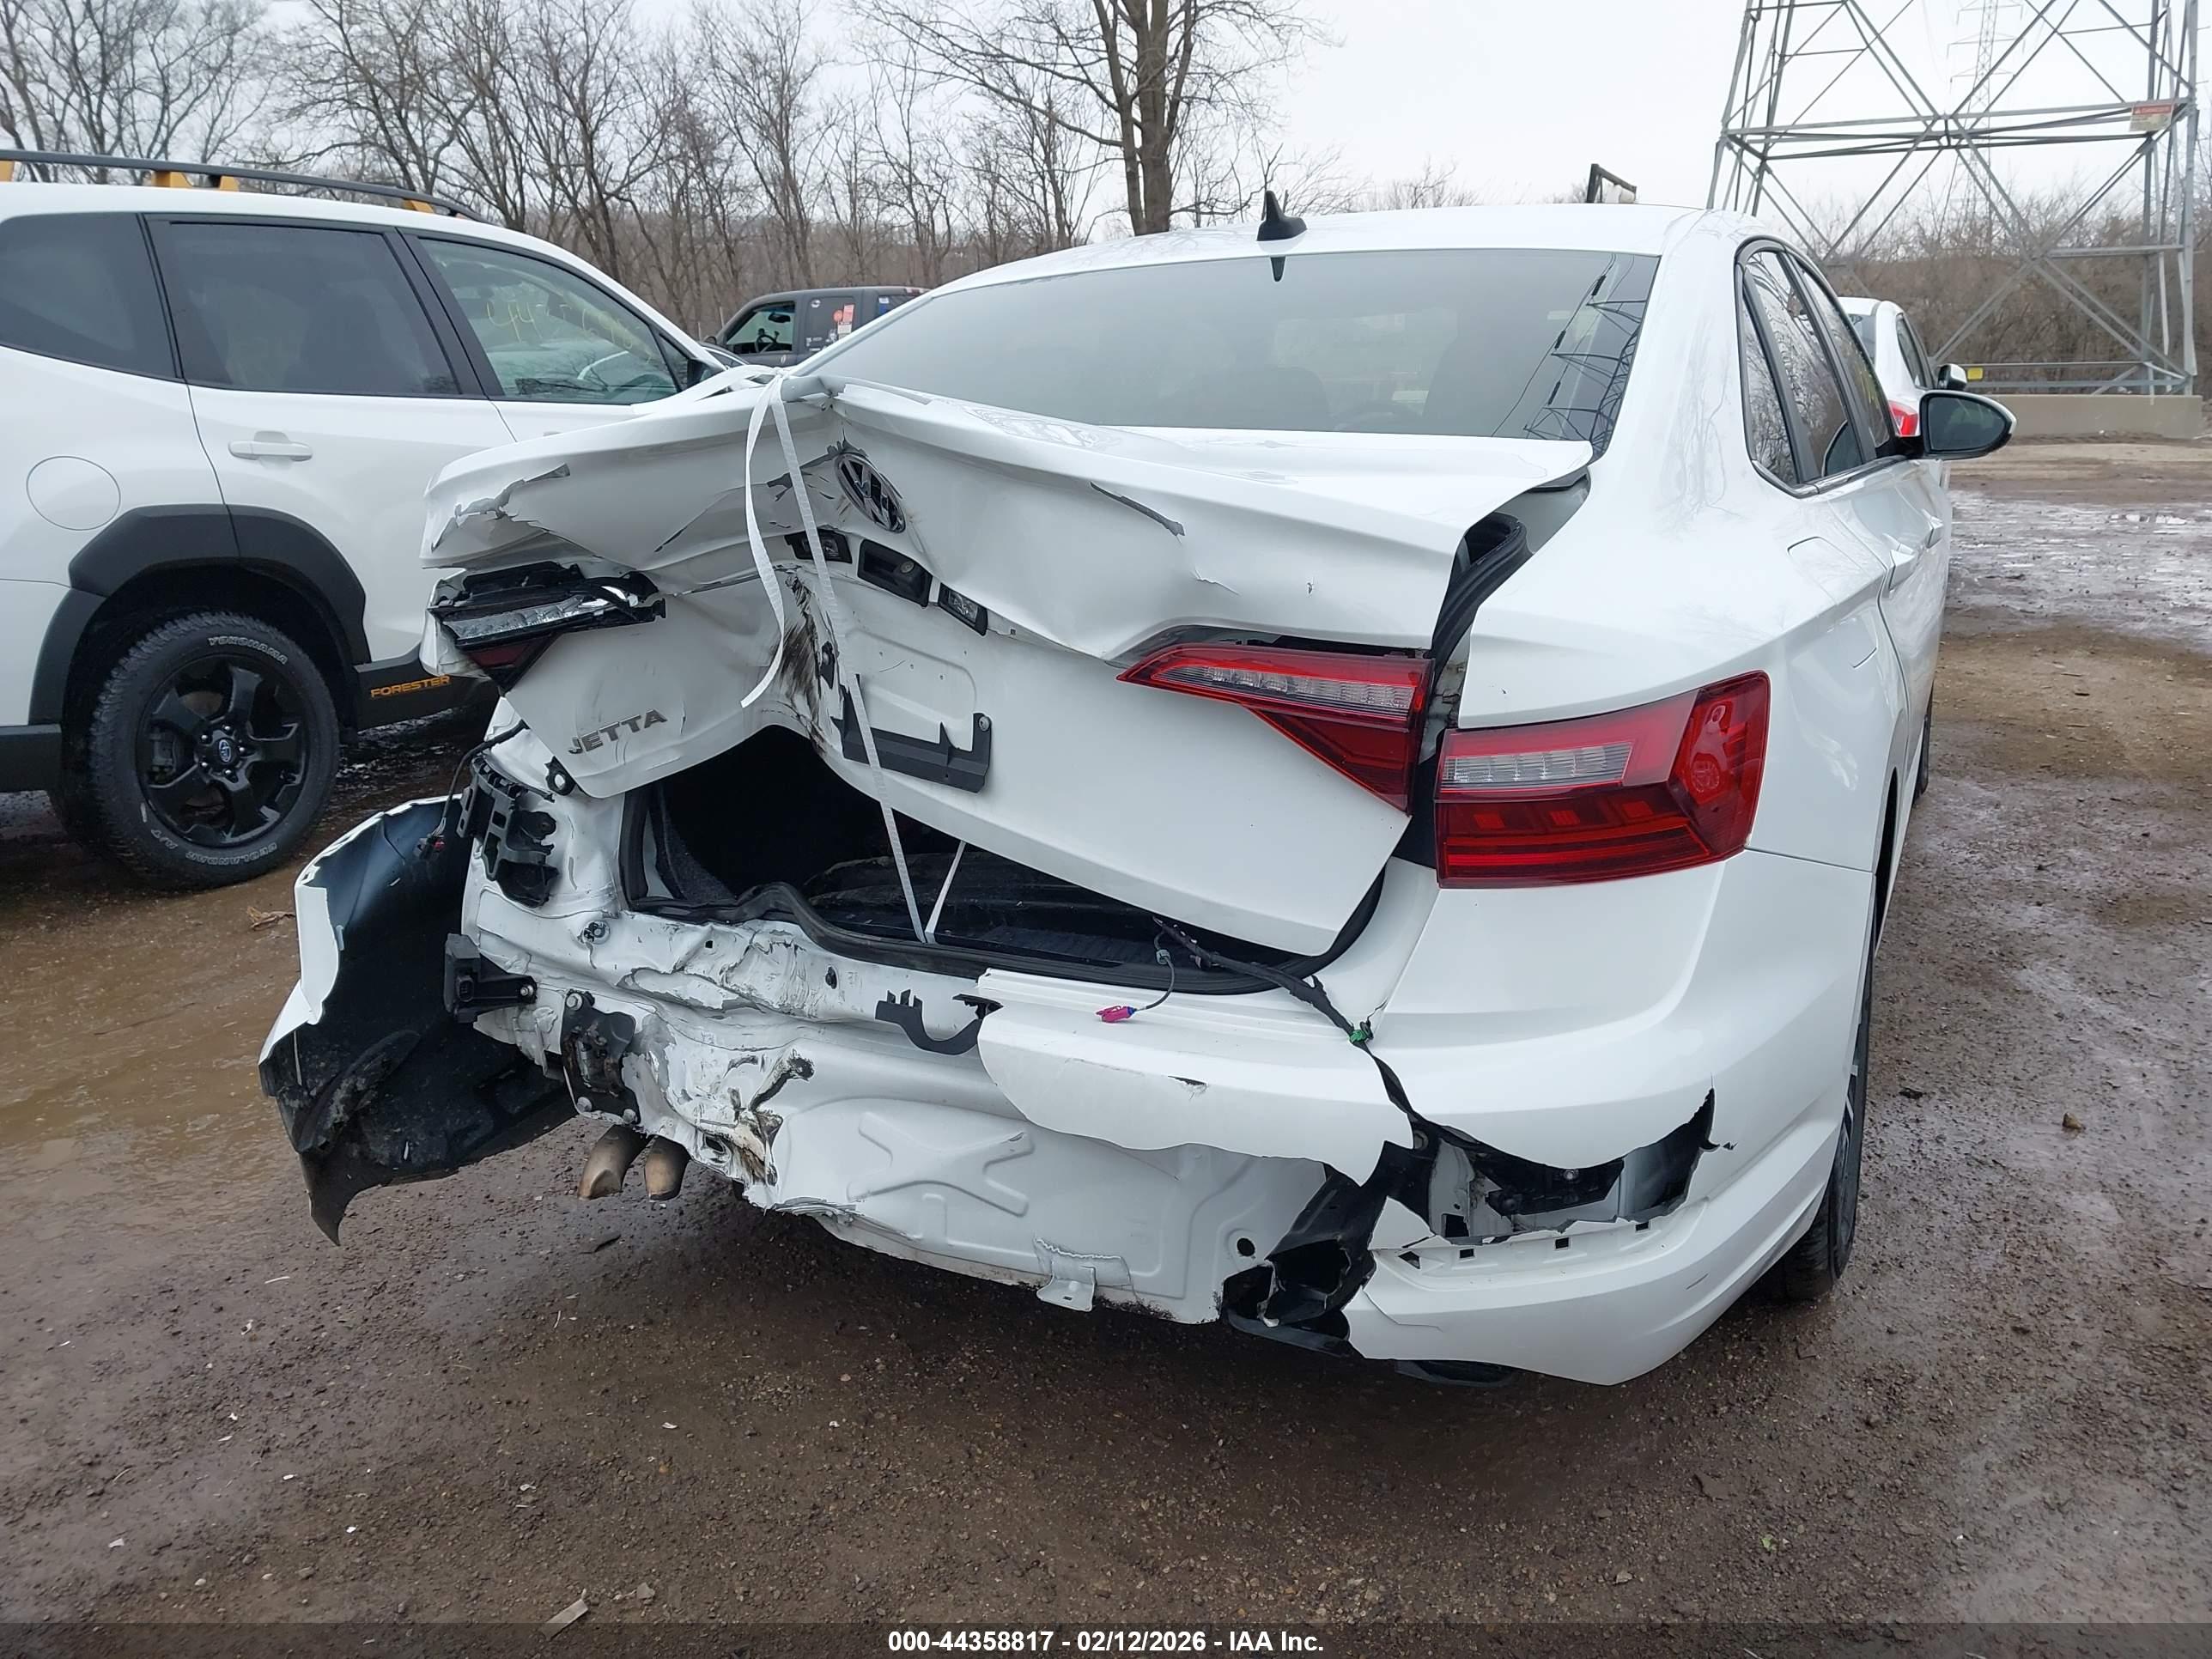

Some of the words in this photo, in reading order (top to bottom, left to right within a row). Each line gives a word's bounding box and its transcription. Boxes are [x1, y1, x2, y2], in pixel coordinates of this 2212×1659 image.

[207, 635, 288, 665] YOKOHAMA
[370, 674, 451, 697] FORESTER
[568, 708, 668, 754] JETTA
[150, 829, 179, 849] A/T
[185, 842, 278, 866] GEOLANDAR
